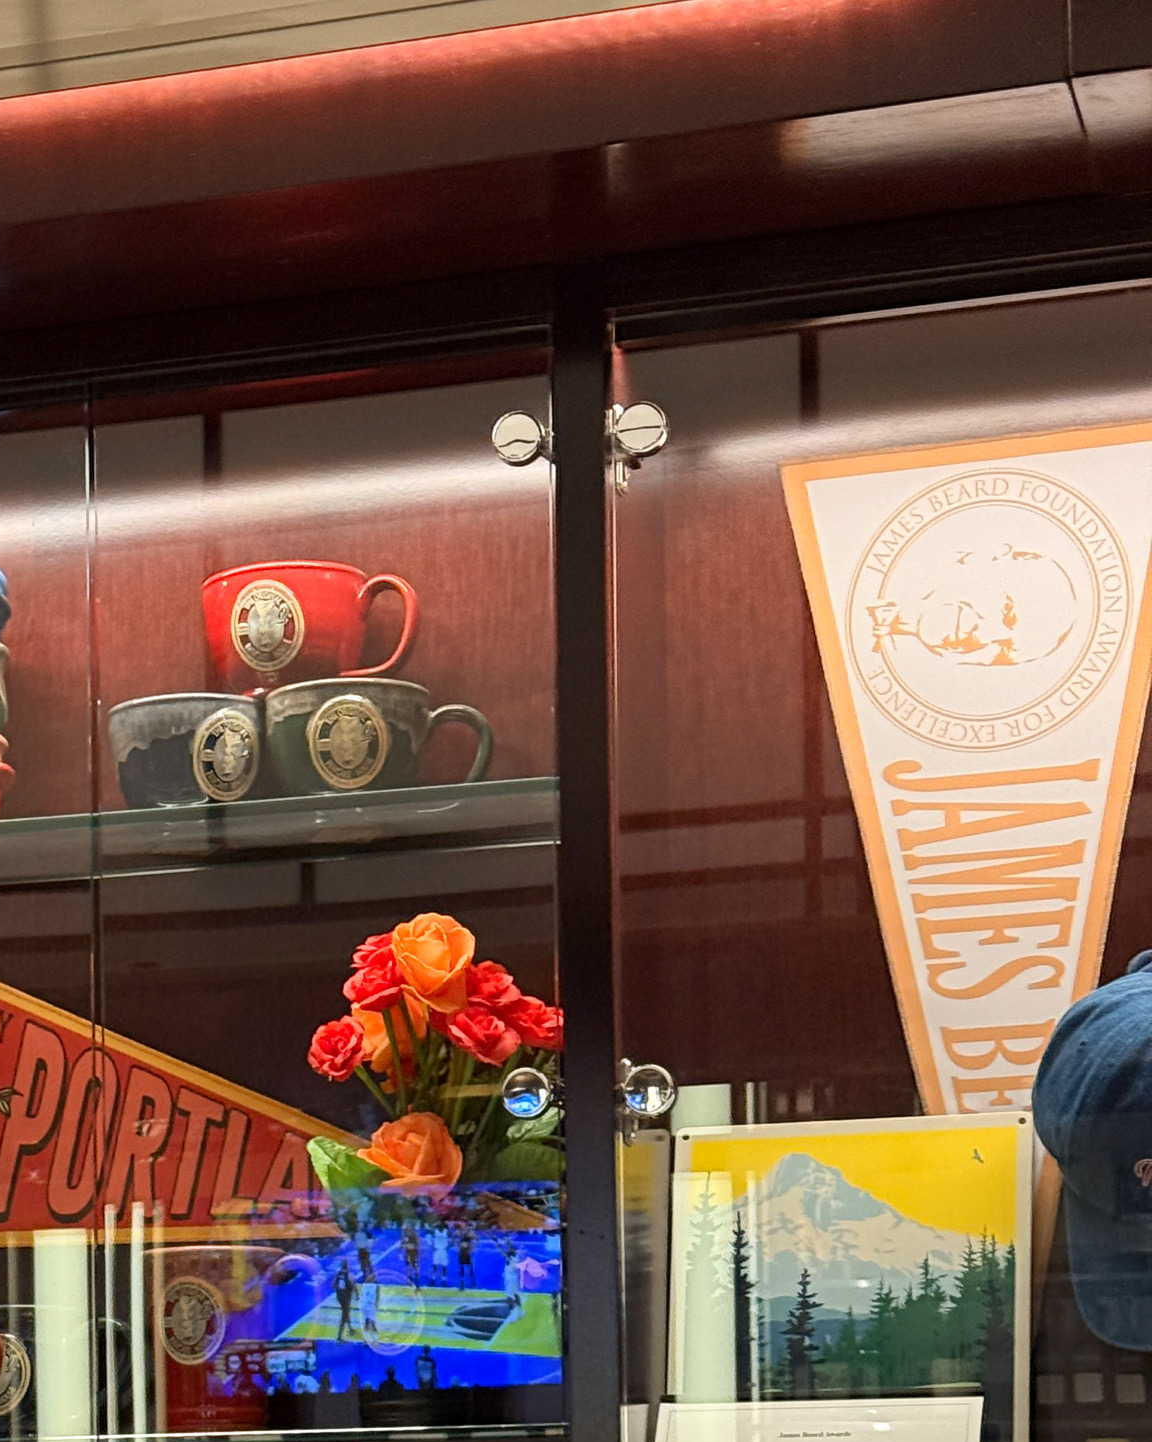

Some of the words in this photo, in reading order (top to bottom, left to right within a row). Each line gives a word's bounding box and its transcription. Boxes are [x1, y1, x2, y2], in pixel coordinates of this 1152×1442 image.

[928, 477, 1010, 515] BEARD
[865, 504, 924, 578] JAMES
[1018, 479, 1124, 613] FOUNDATION
[1059, 623, 1118, 707] AWARD
[868, 667, 996, 744] EXCELLENCE
[1004, 704, 1056, 738] FOR
[883, 758, 1101, 1001] JAMES
